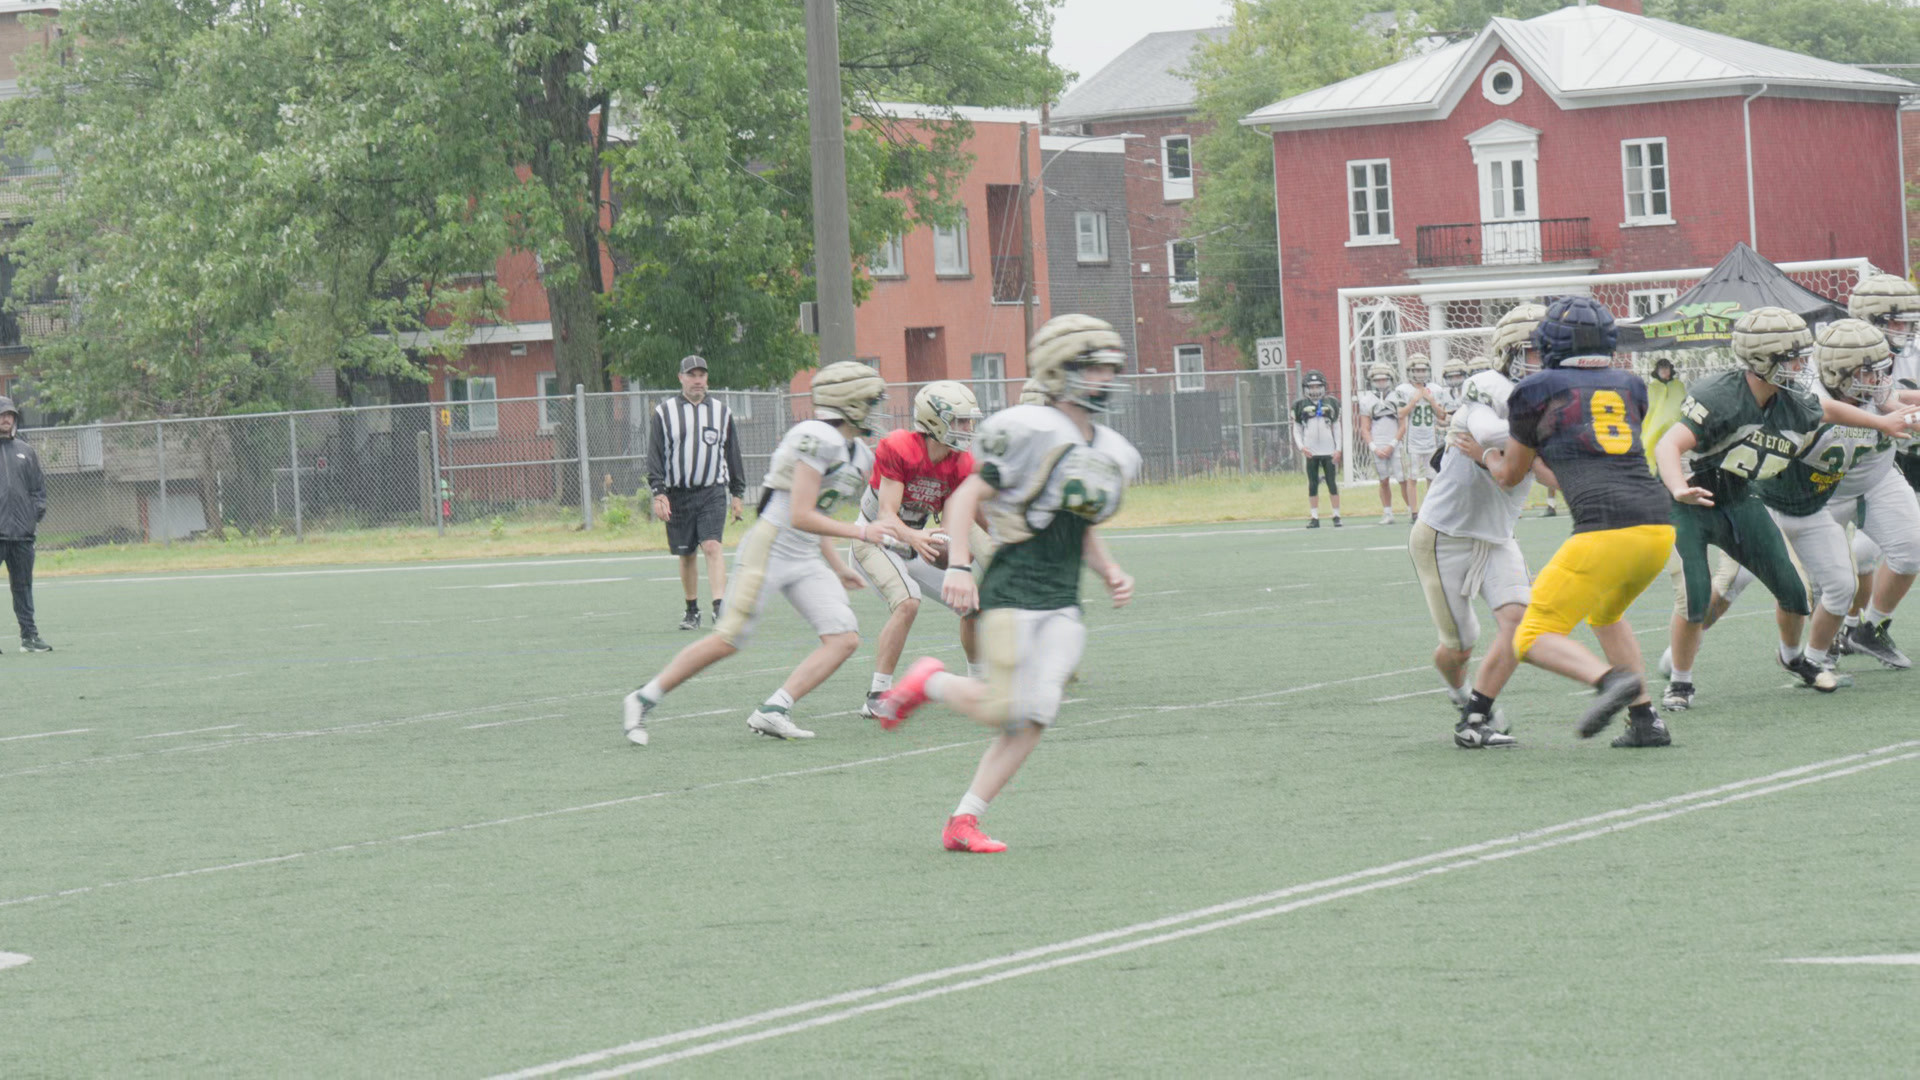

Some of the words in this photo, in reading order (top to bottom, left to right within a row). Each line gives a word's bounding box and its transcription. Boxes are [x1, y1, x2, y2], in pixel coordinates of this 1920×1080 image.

[1641, 317, 1699, 338] VERT
[1261, 347, 1282, 366] 30
[1412, 405, 1433, 427] 88
[1590, 390, 1633, 454] 8
